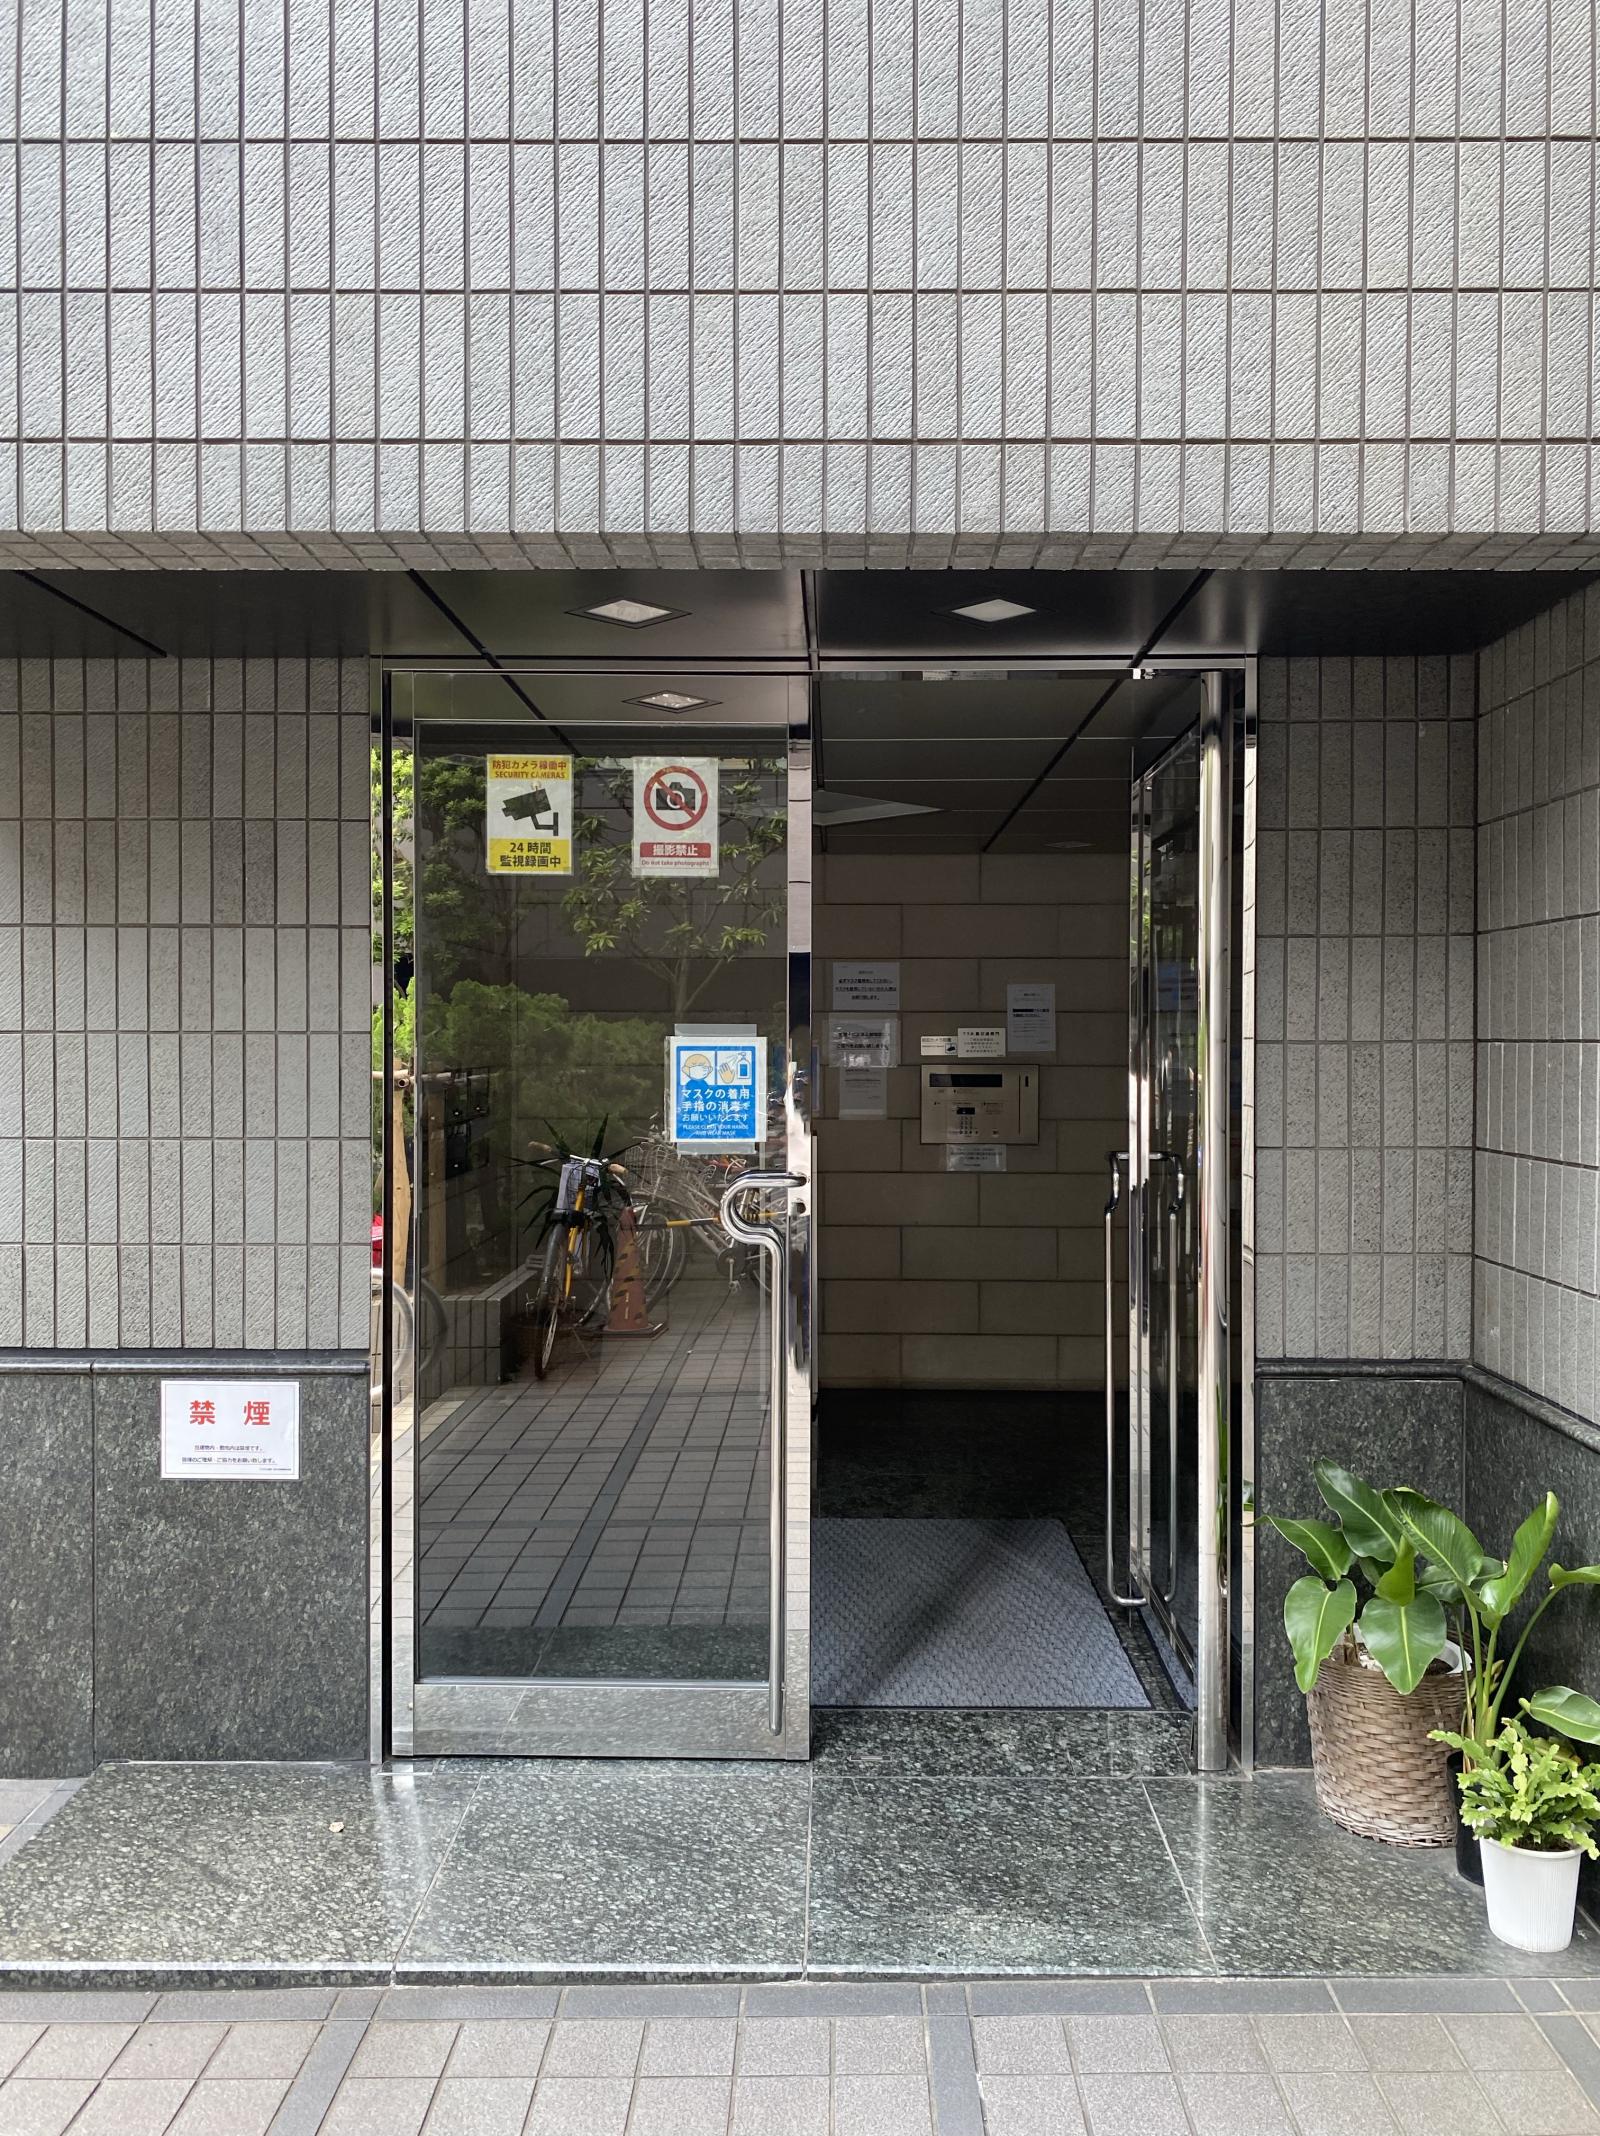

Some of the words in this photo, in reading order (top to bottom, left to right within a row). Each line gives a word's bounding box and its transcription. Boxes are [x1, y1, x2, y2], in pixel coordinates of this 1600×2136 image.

[495, 771, 528, 779] SECURITY
[530, 771, 565, 779] CAMERAS
[509, 842, 524, 853] 24
[527, 842, 552, 854] 時間
[652, 844, 698, 856] 撮影禁止
[500, 855, 561, 868] 監視録画中
[681, 1088, 750, 1100] マスクの着用
[681, 1101, 751, 1112] 手指の消毒を
[682, 1113, 748, 1122] お願いいたします
